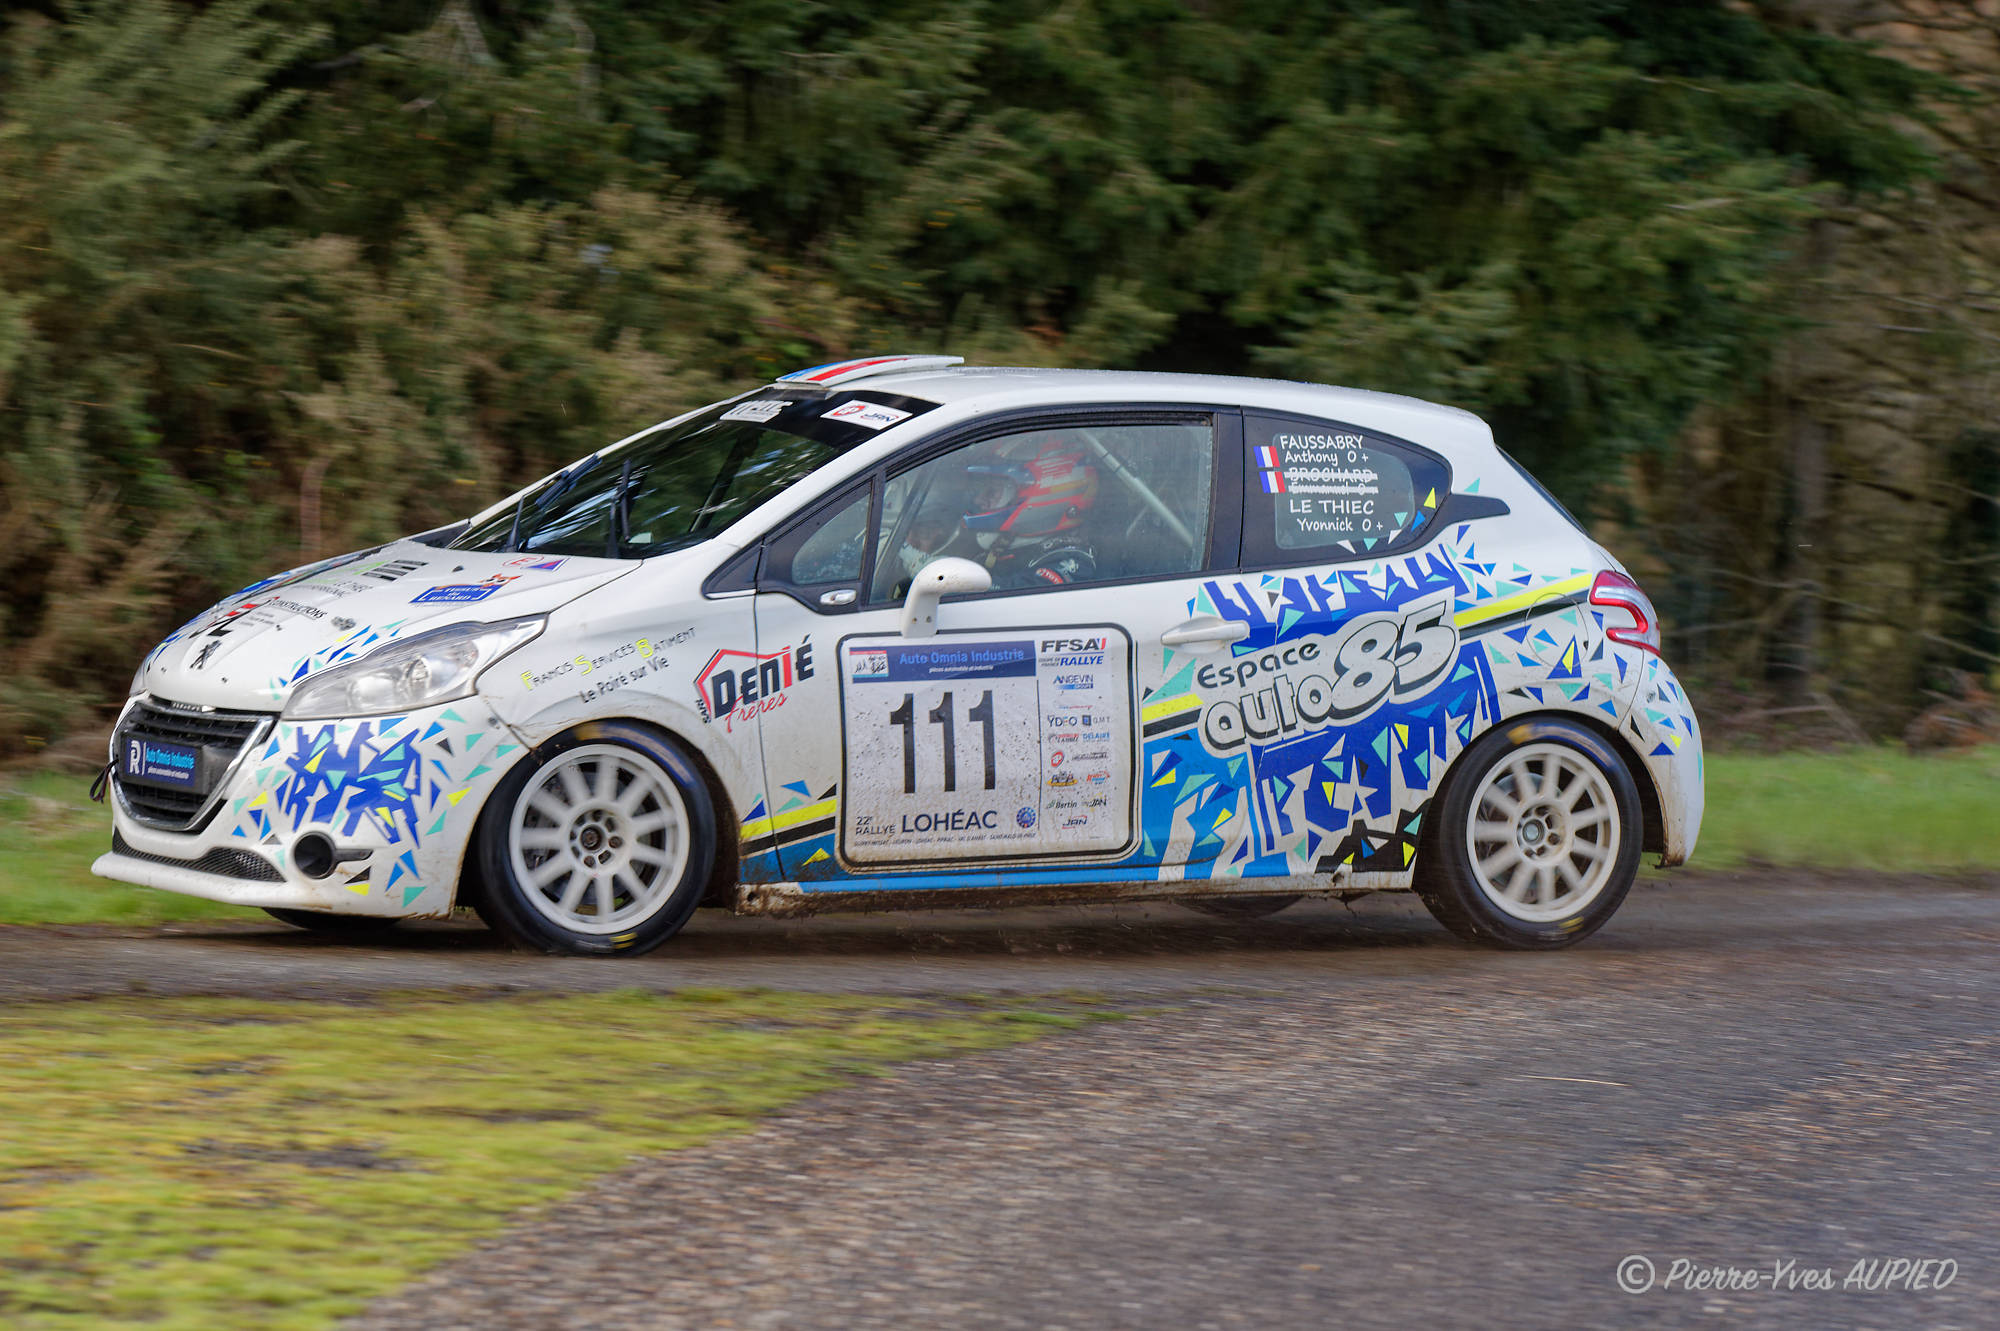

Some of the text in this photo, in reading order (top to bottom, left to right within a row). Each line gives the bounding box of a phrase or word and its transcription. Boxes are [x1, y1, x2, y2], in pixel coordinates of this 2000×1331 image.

[1280, 435, 1363, 449] FAUSSABRY
[1285, 450, 1338, 466] Anthony
[1289, 499, 1375, 514] LE THIEC
[1296, 517, 1354, 532] Yvonnick
[1041, 638, 1099, 653] FFSA
[574, 643, 636, 676] SERVICES
[899, 652, 928, 665] Auto
[930, 650, 968, 664] Omnia
[970, 648, 1025, 663] Industrie
[1060, 655, 1104, 666] RALLYE
[1197, 641, 1321, 689] Espace
[579, 656, 670, 704] Le Poiré sur Vie
[889, 690, 996, 794] 111
[1056, 800, 1078, 808] Bertin
[902, 808, 998, 832] LOHÉAC
[856, 823, 897, 836] RALLYE
